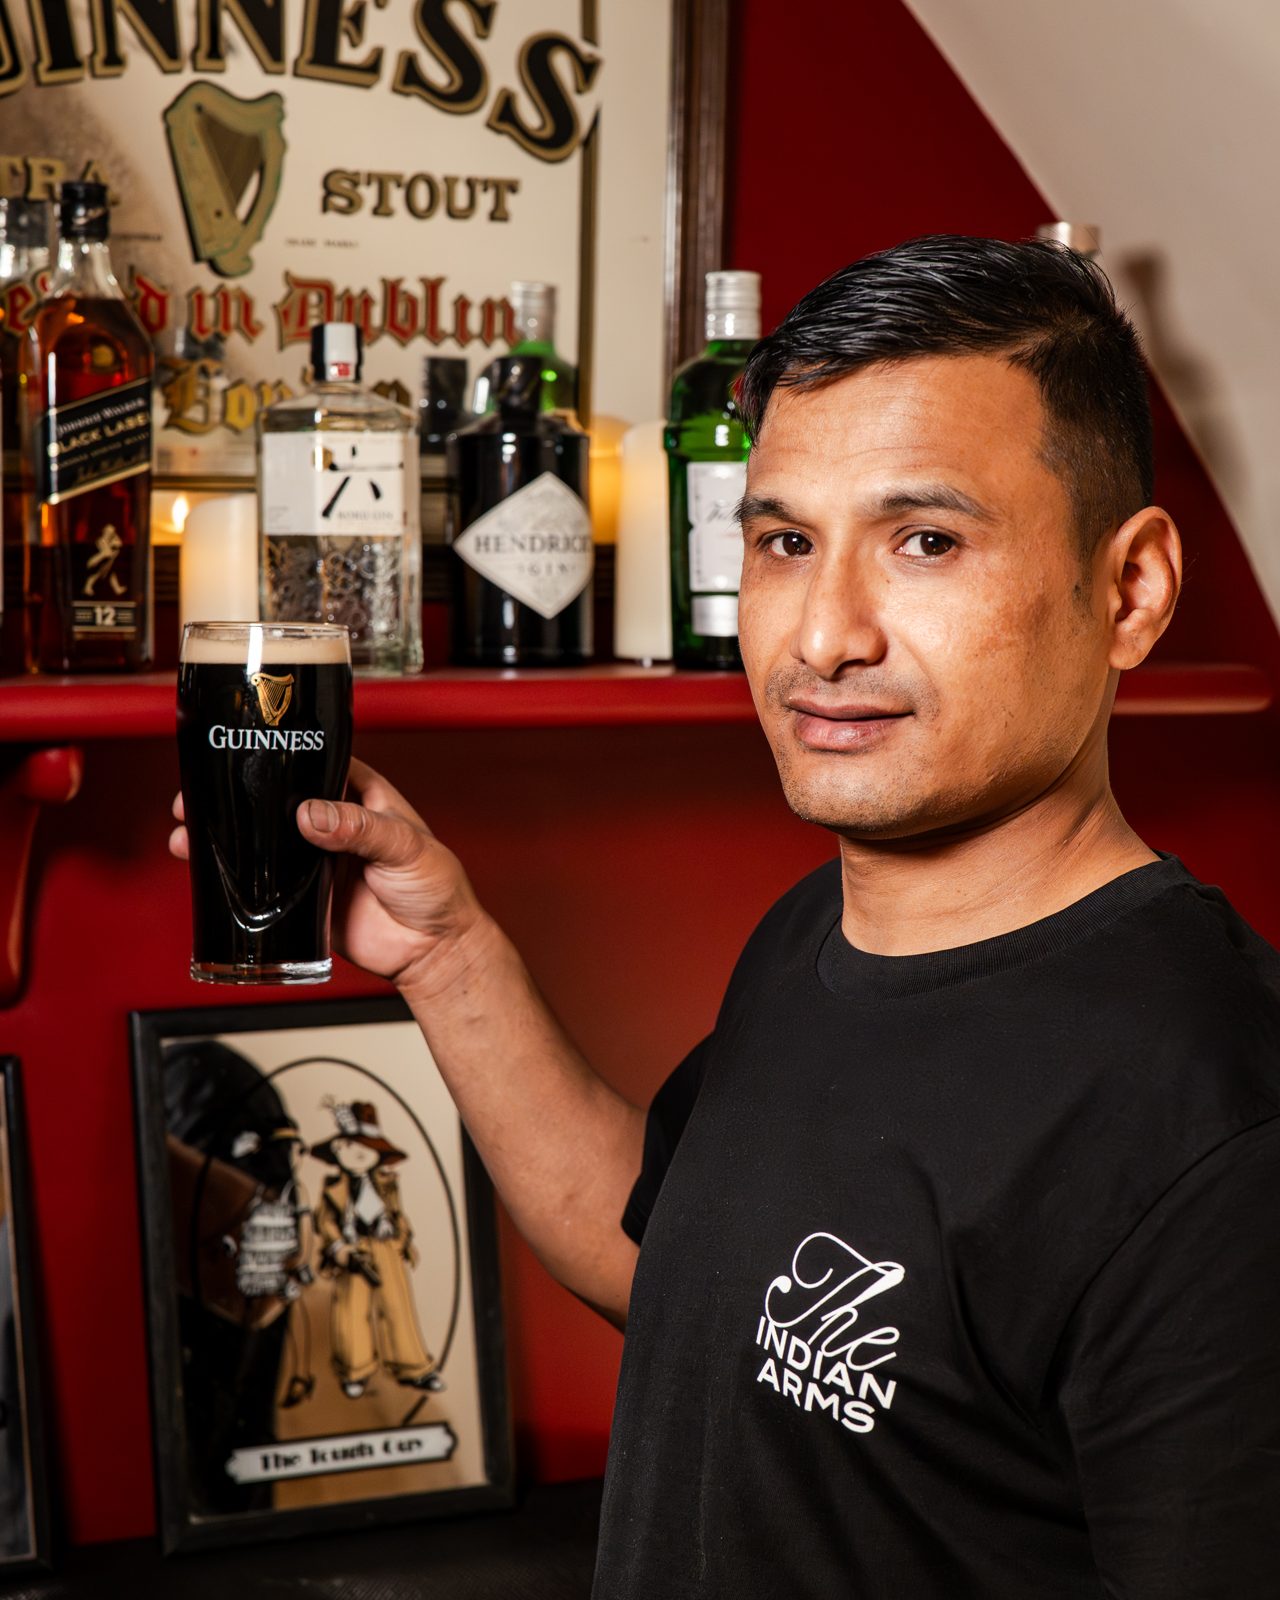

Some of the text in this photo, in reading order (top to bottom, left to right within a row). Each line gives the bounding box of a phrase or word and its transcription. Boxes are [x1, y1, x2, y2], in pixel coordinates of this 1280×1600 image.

[0, 0, 602, 164] INNESS
[321, 168, 521, 222] STOUT
[271, 270, 522, 352] Dublin
[94, 605, 116, 626] 12
[208, 724, 325, 751] GUINNESS
[765, 1232, 905, 1371] The
[756, 1316, 897, 1409] INDIAN
[757, 1358, 875, 1433] ARMS
